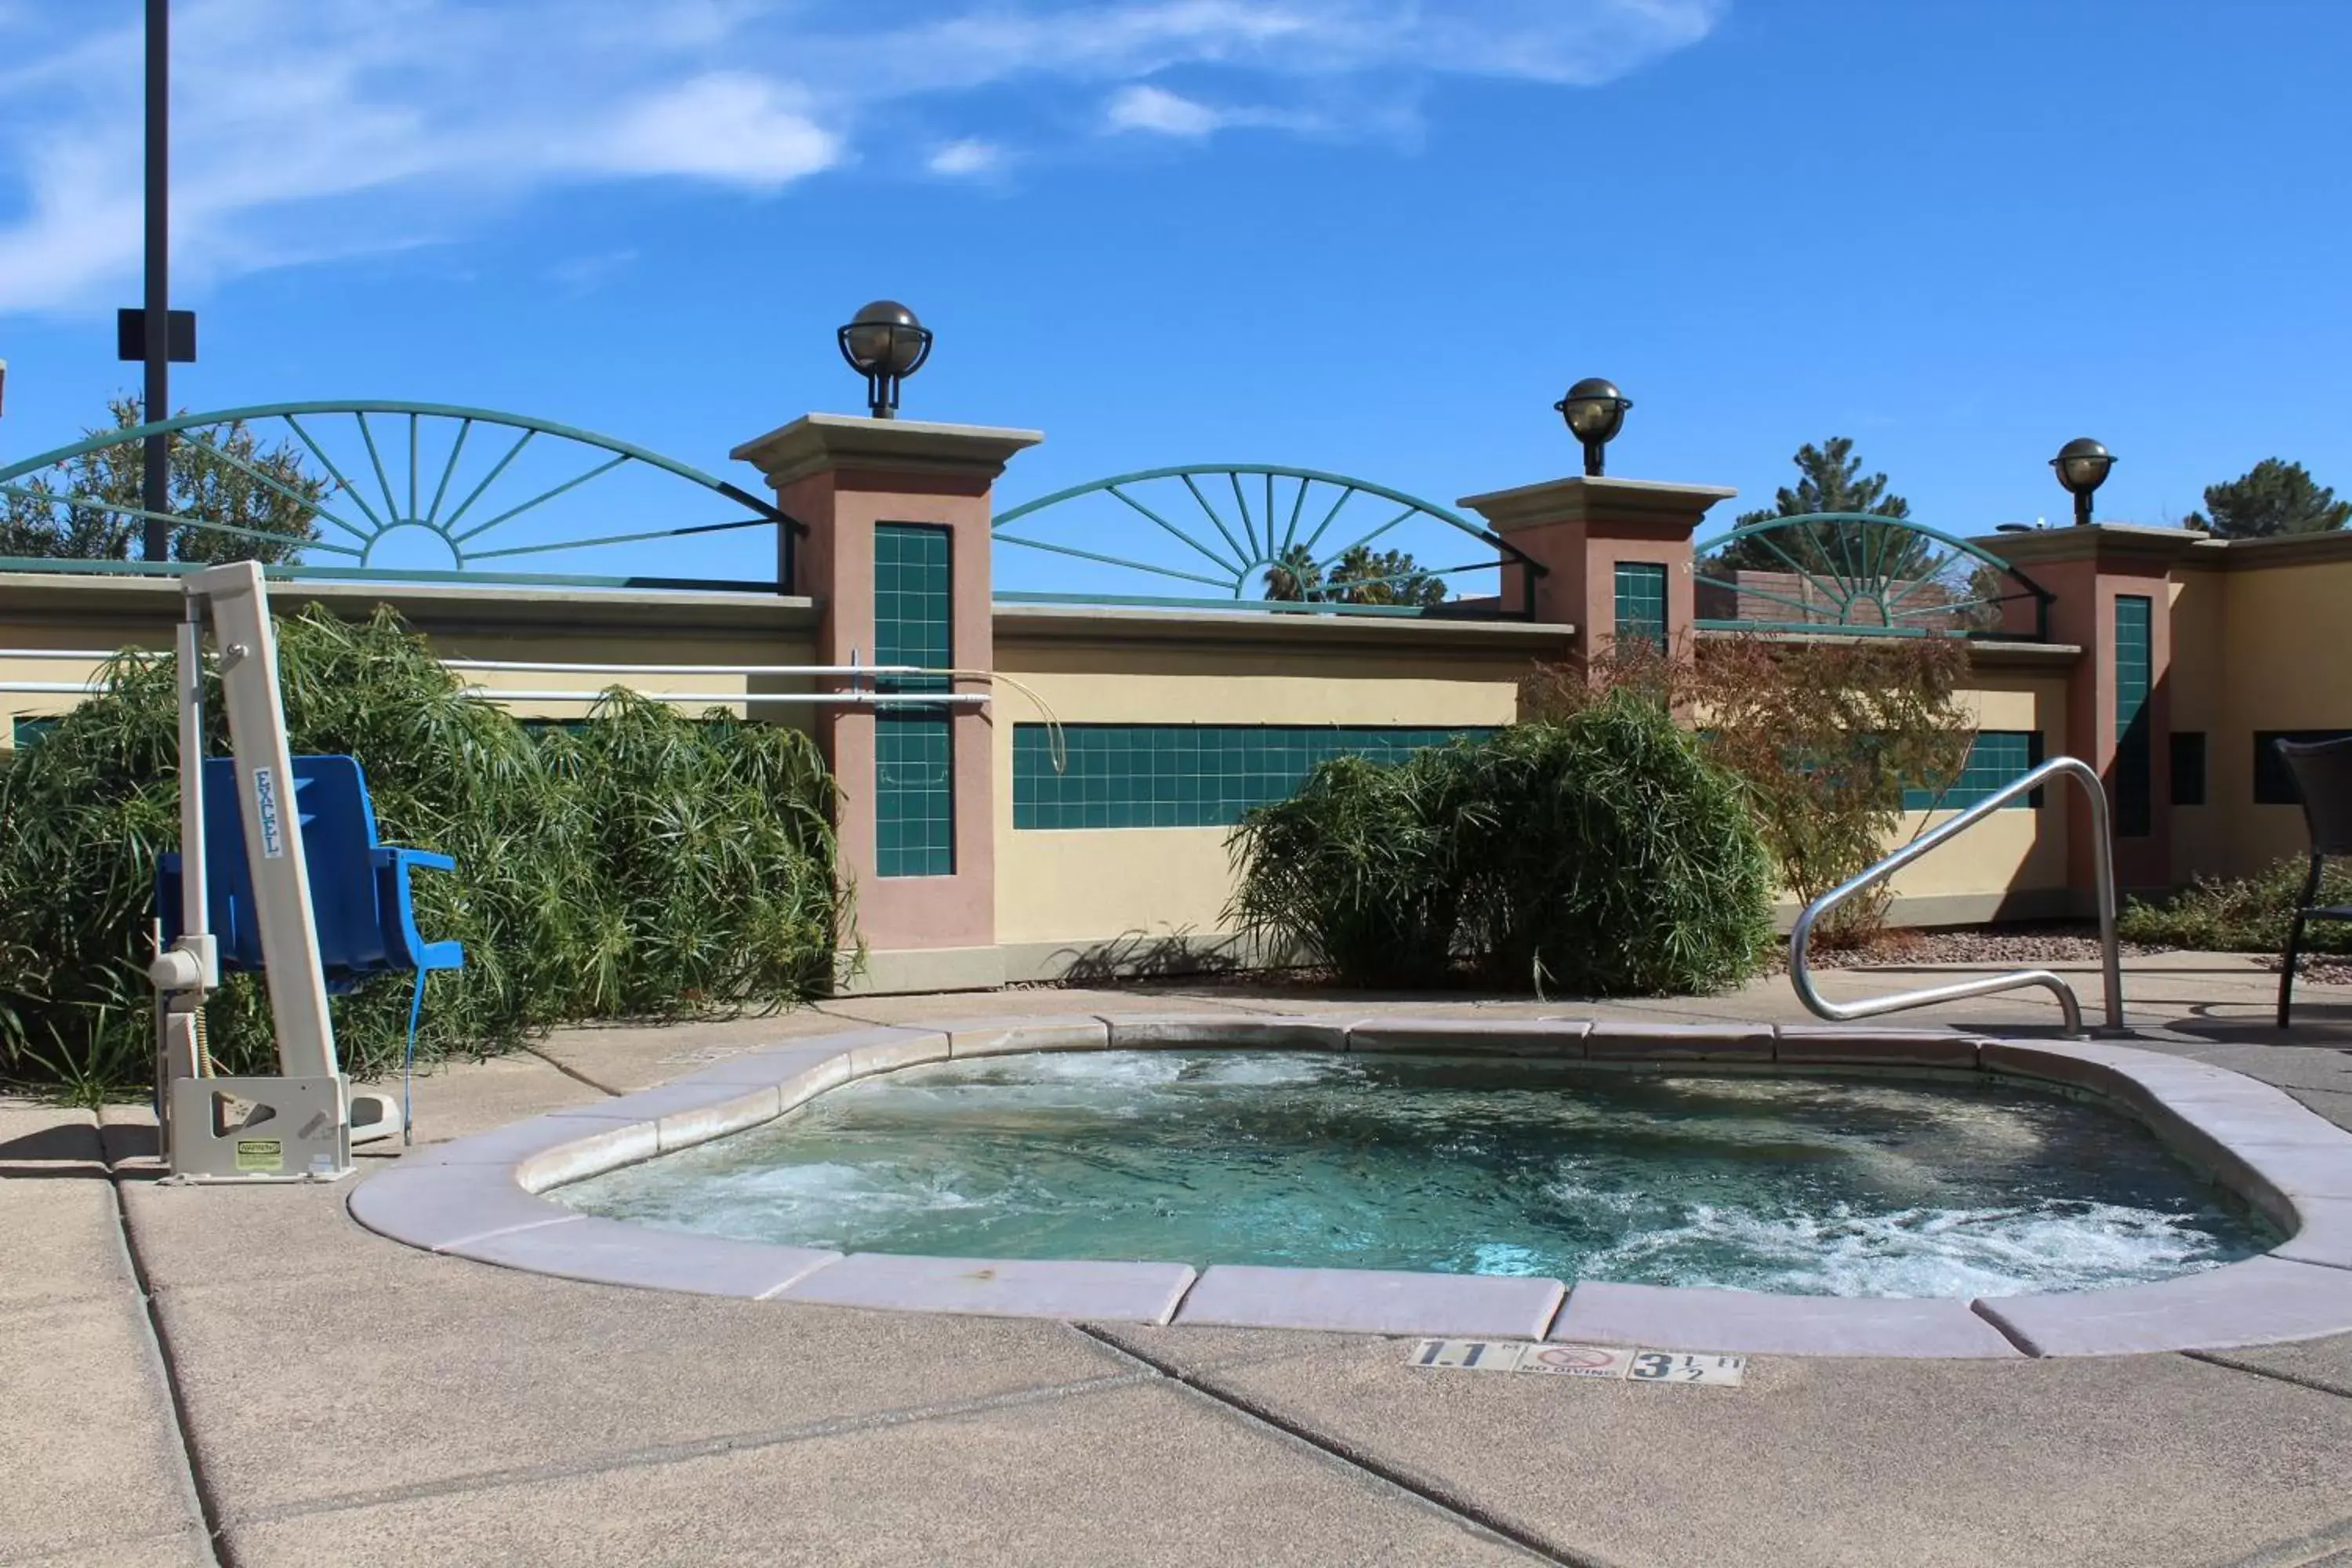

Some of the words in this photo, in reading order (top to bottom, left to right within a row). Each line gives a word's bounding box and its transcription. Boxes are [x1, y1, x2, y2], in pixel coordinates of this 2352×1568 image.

[256, 771, 279, 853] EXCEL
[1420, 1341, 1486, 1367] 1.1
[1634, 1354, 1673, 1378] 3
[1554, 1367, 1618, 1375] DIVING
